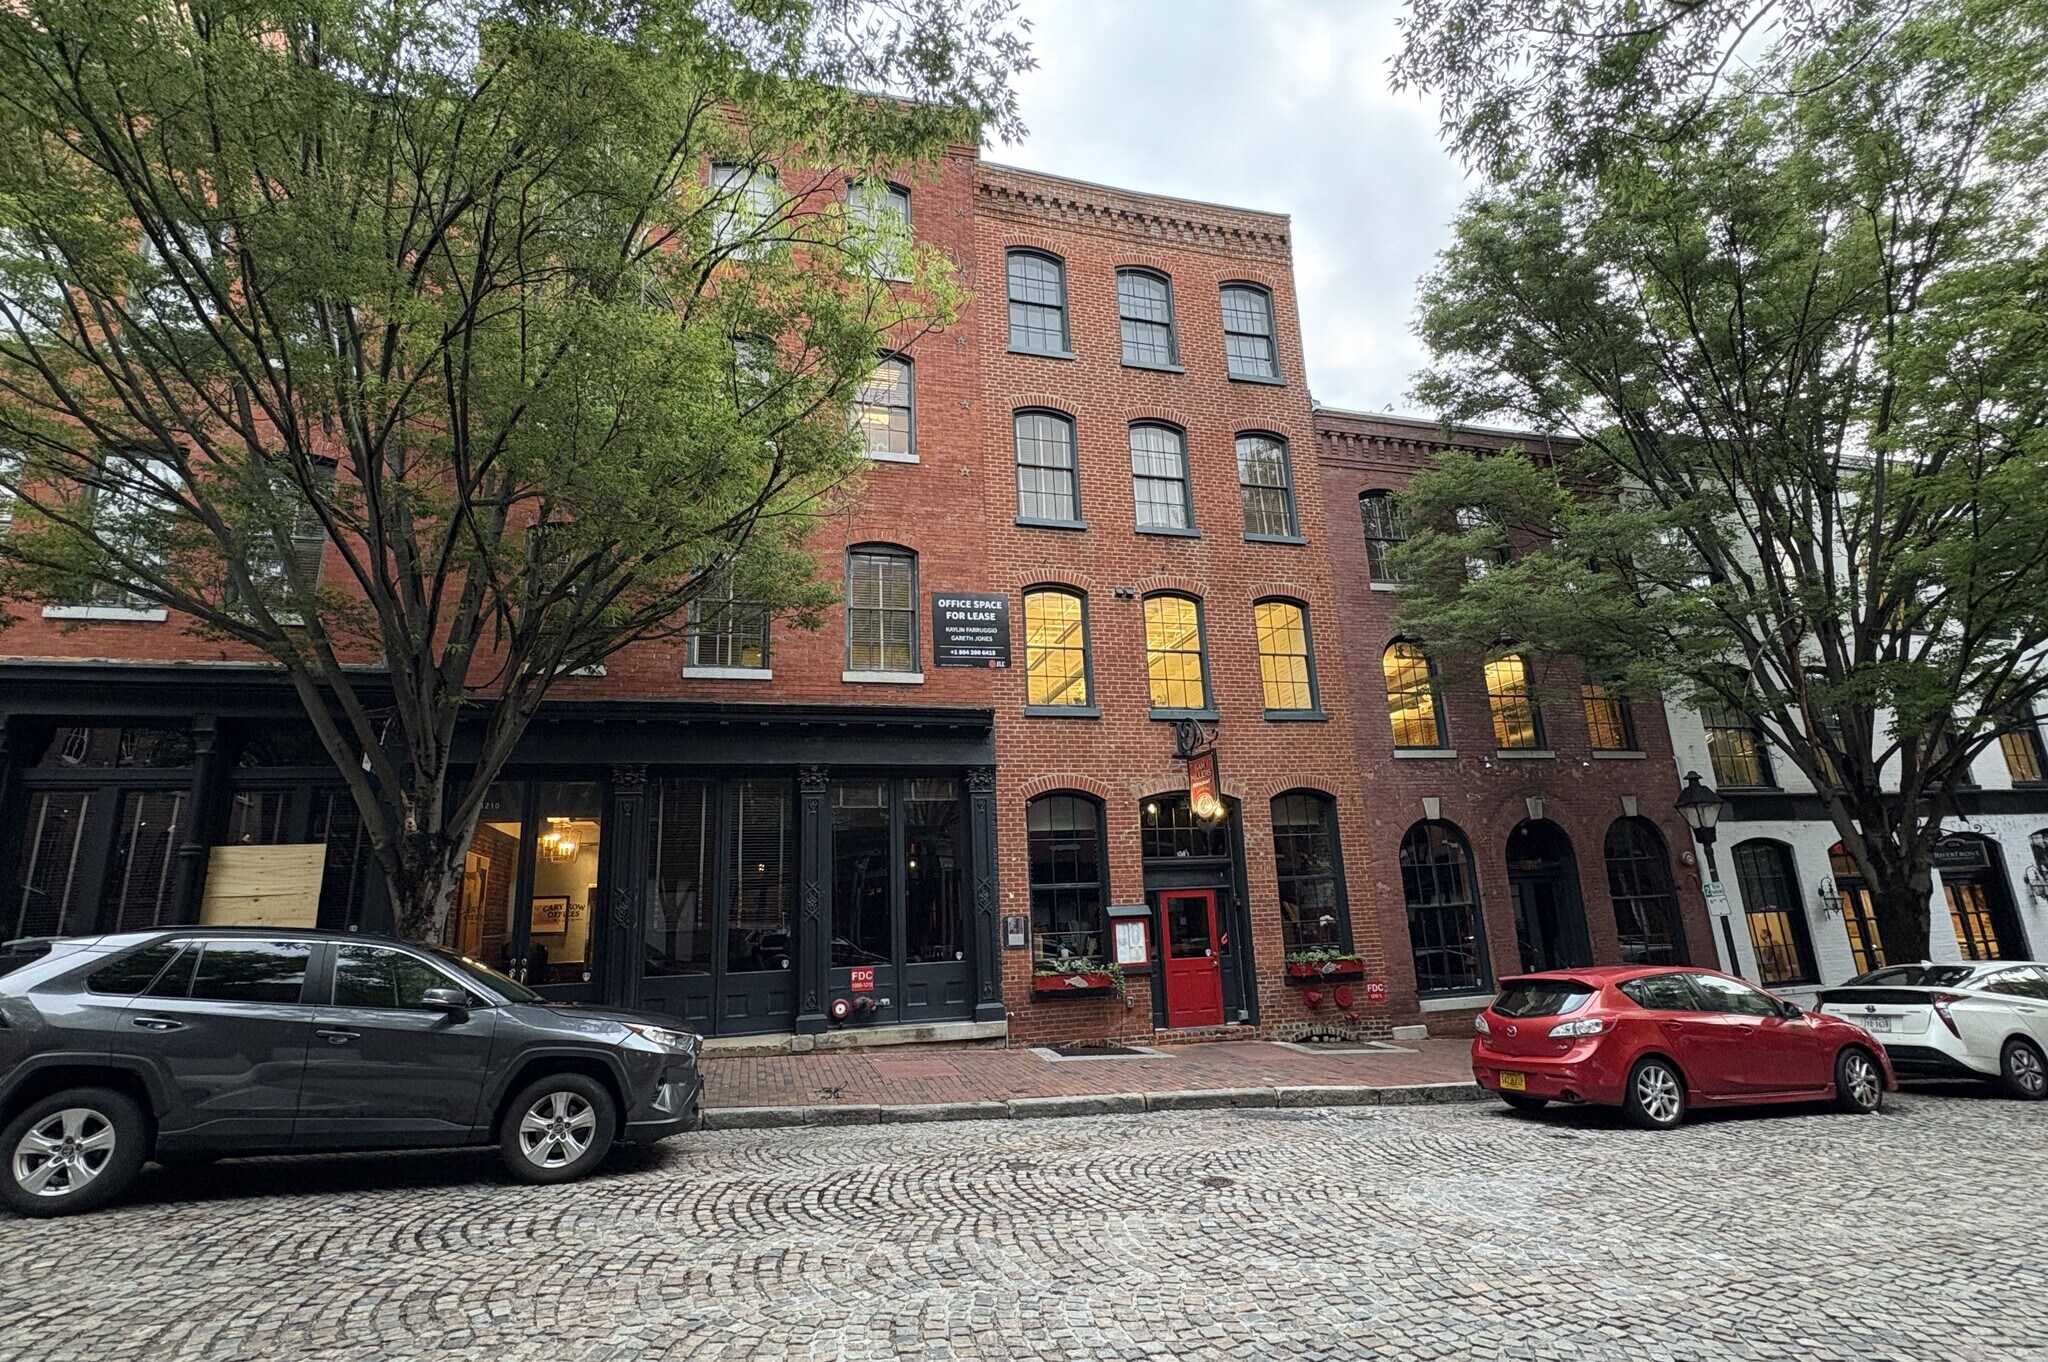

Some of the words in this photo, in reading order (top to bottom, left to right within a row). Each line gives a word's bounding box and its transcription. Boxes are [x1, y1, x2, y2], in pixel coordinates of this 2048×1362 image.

[938, 599, 972, 608] OFFICE
[973, 600, 1003, 609] SPACE
[946, 611, 966, 620] FOR
[967, 612, 996, 621] LEASE
[542, 903, 565, 913] CARY
[567, 903, 586, 911] ROW
[852, 970, 874, 981] FDC
[1367, 983, 1384, 992] FDC
